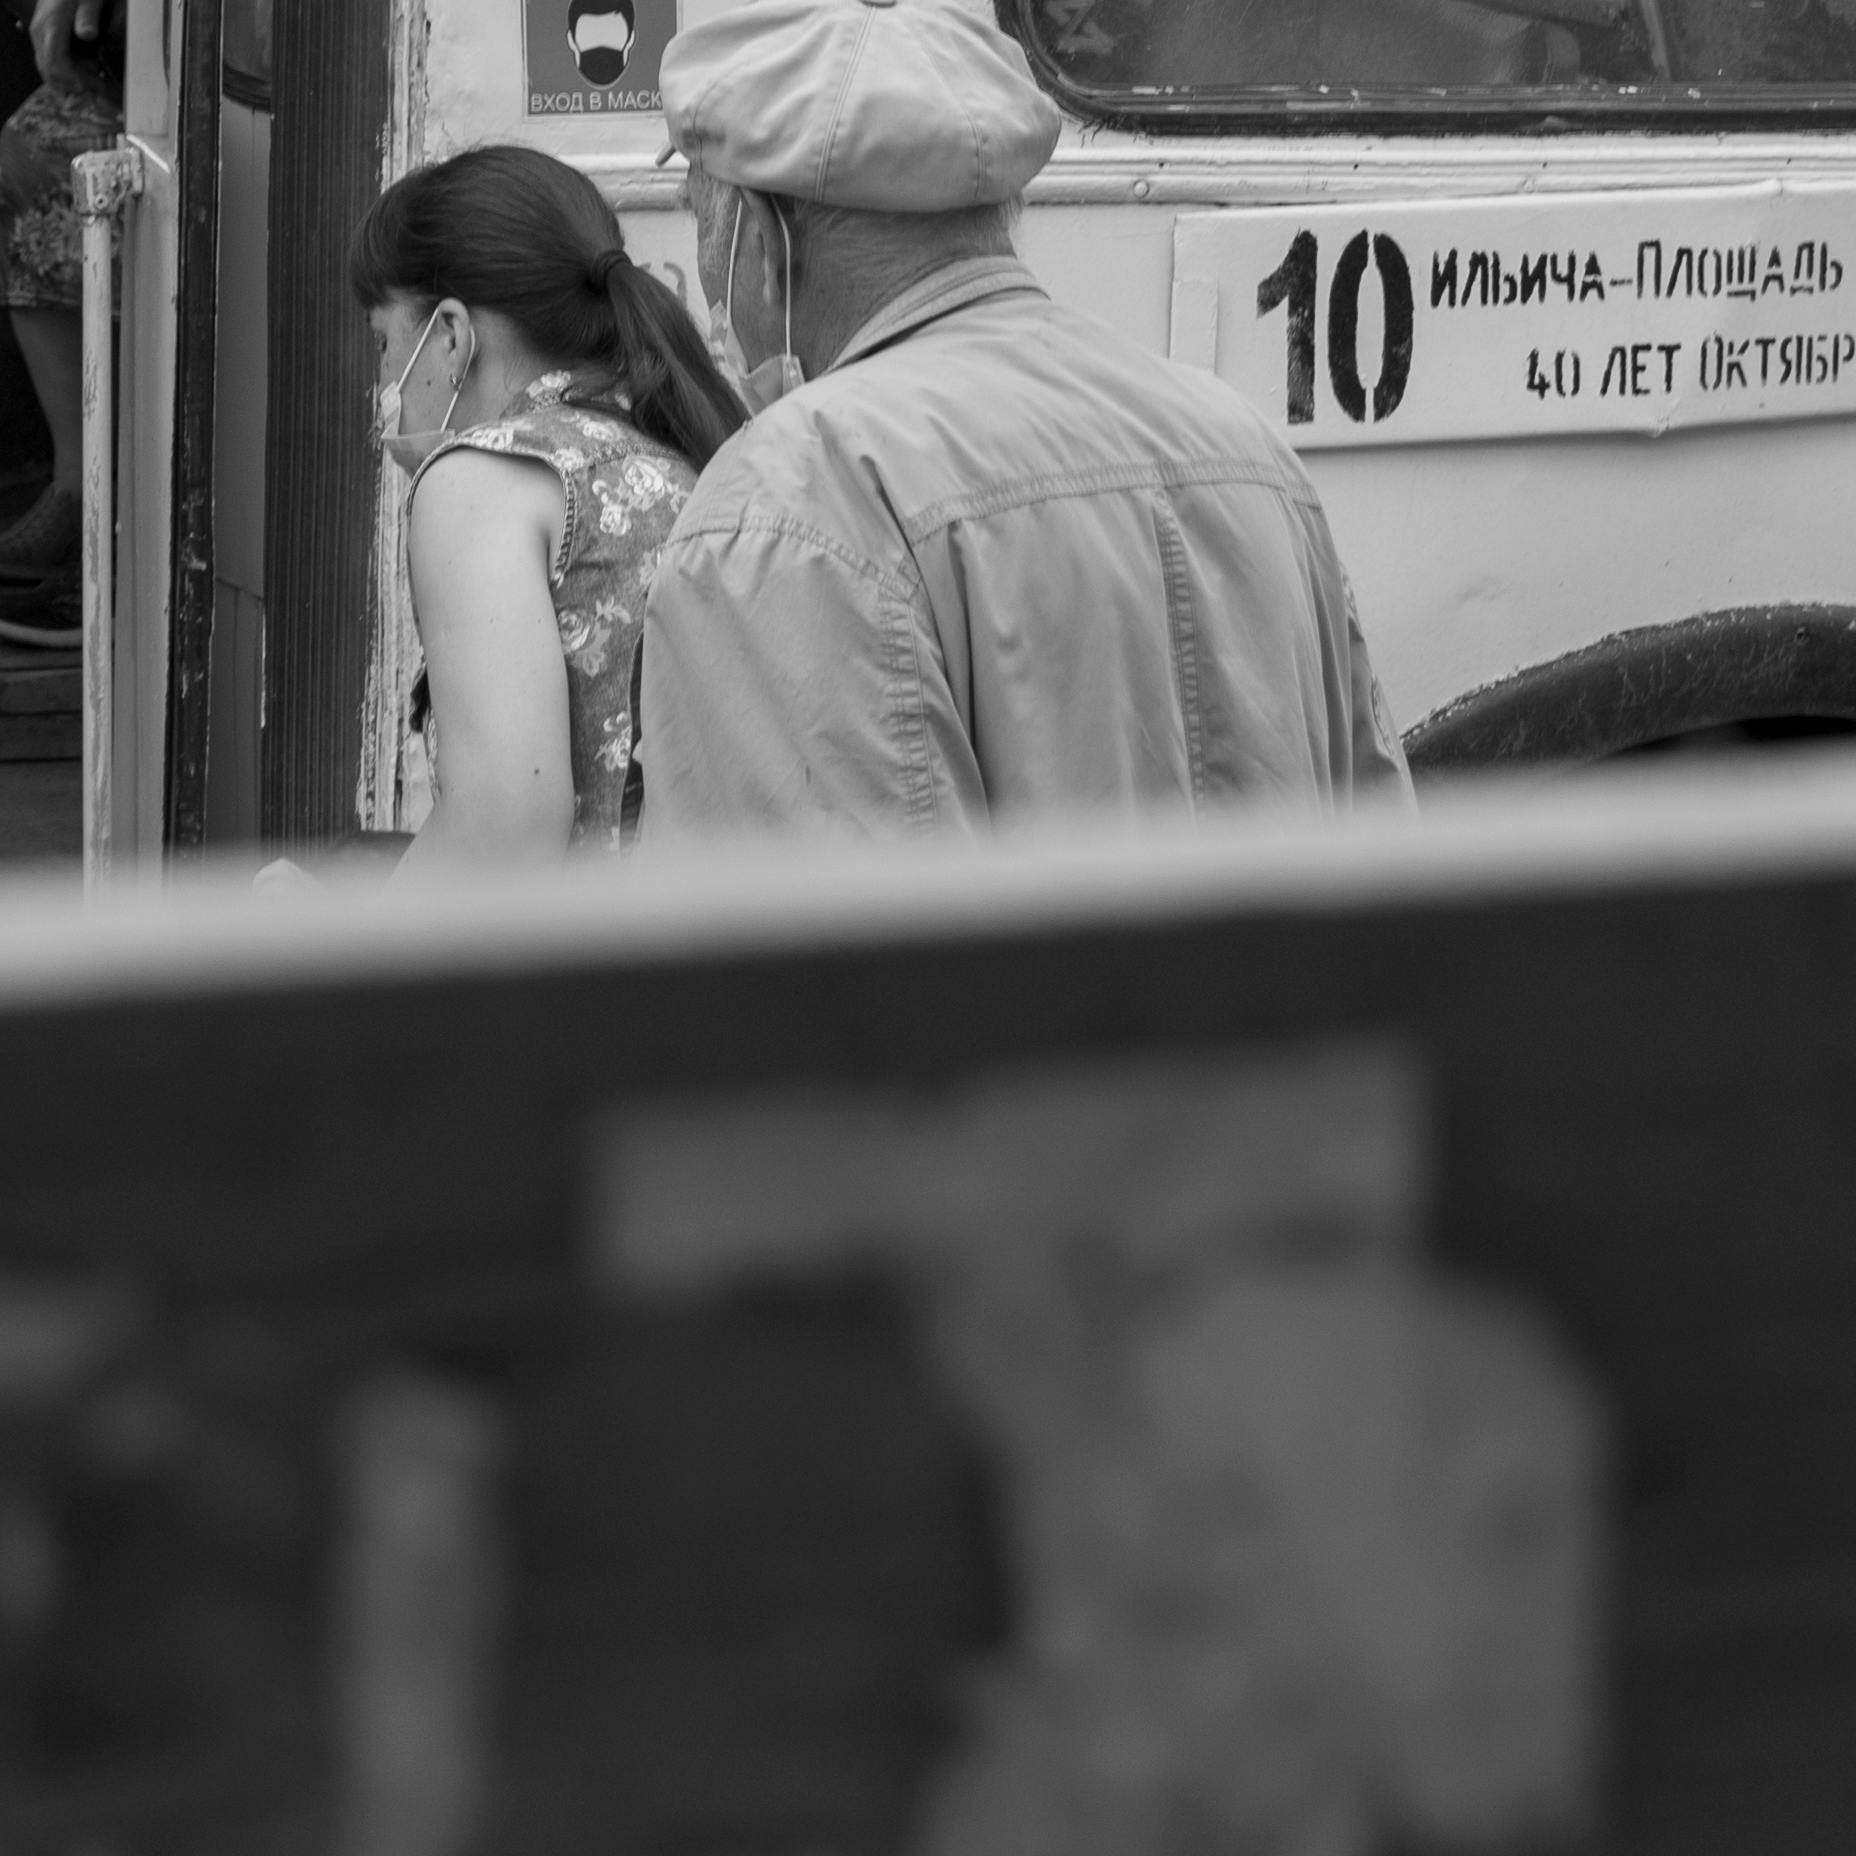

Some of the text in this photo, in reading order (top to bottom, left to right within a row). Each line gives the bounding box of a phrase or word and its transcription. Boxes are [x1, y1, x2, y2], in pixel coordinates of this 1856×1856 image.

[530, 89, 663, 114] ВХОД В МАСК
[1254, 228, 1415, 426] 10
[1526, 346, 1581, 400] 40
[1600, 342, 1682, 397] ЛЕТ
